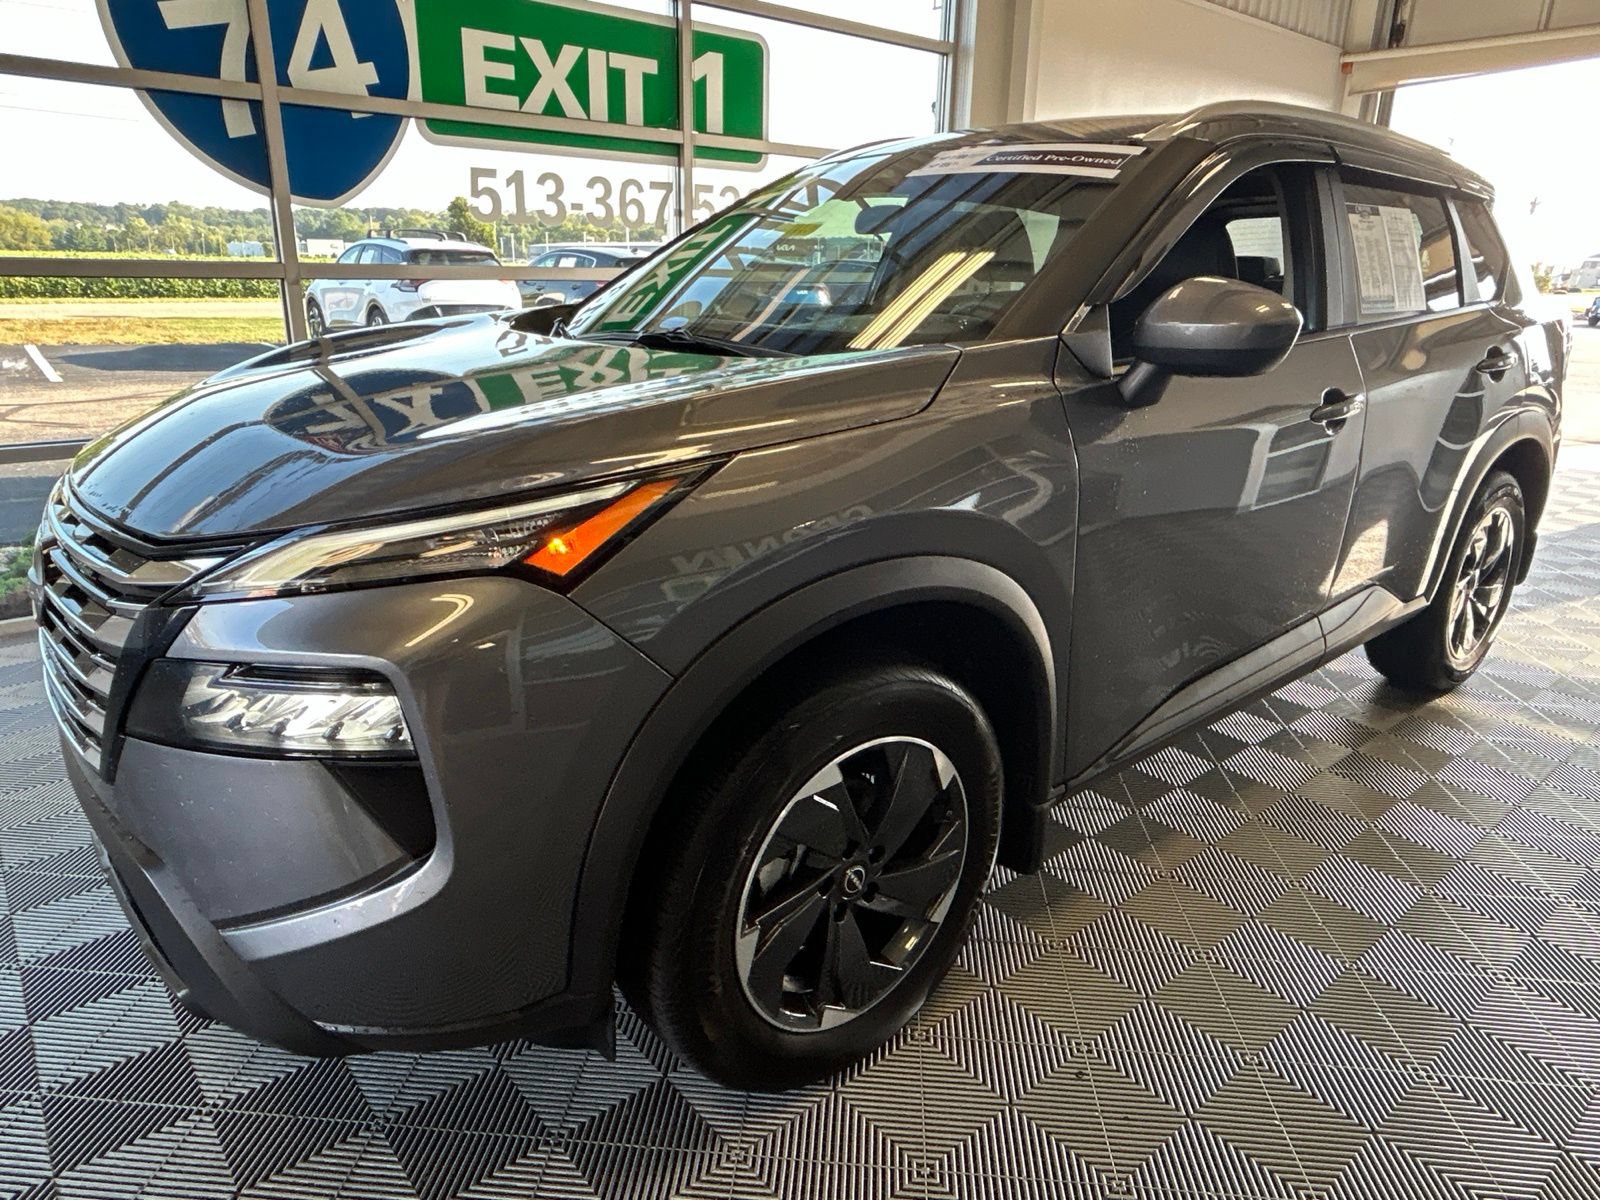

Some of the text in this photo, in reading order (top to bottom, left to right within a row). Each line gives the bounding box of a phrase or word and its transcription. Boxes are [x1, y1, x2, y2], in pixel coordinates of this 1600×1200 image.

[157, 0, 379, 138] 74
[461, 27, 723, 134] EXIT 1
[985, 152, 1041, 163] Certified
[1046, 154, 1123, 166] Pre-Owned
